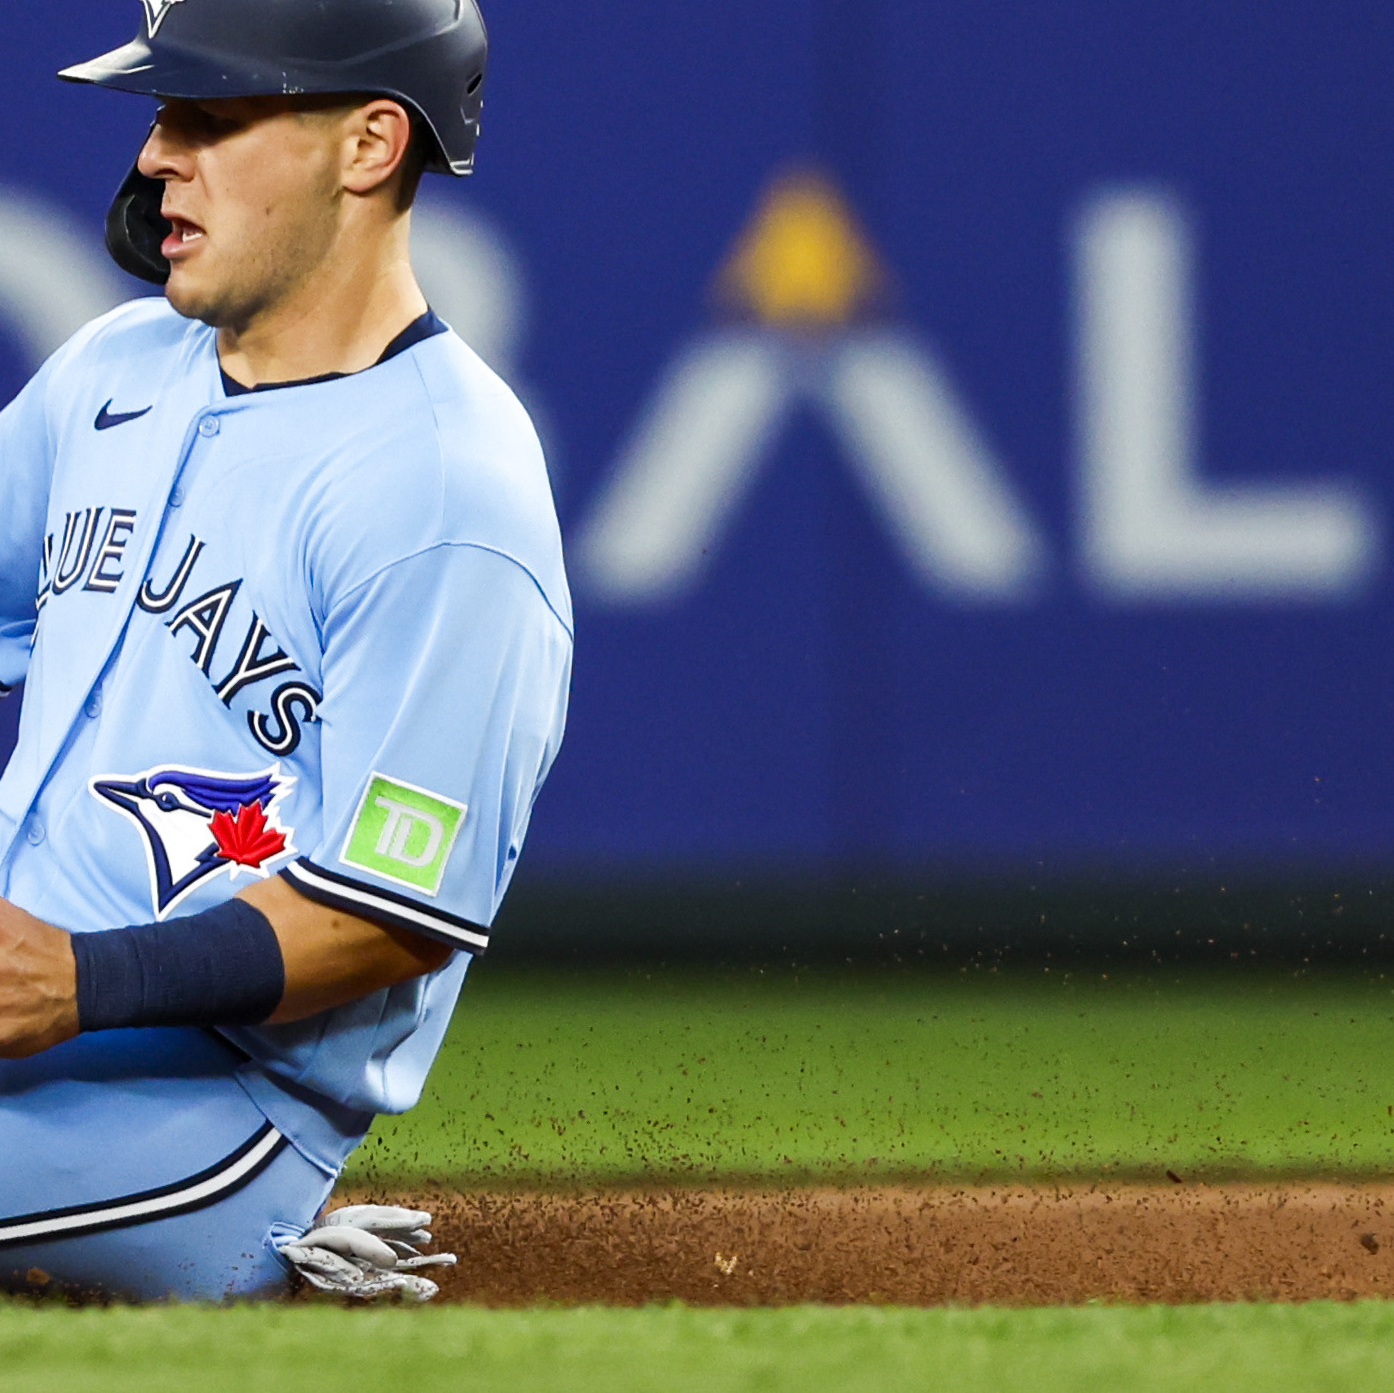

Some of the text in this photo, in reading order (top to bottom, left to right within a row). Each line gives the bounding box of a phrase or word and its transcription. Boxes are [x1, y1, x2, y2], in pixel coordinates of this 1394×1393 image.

[29, 504, 325, 758] LUE JAYS
[374, 794, 444, 869] TD
